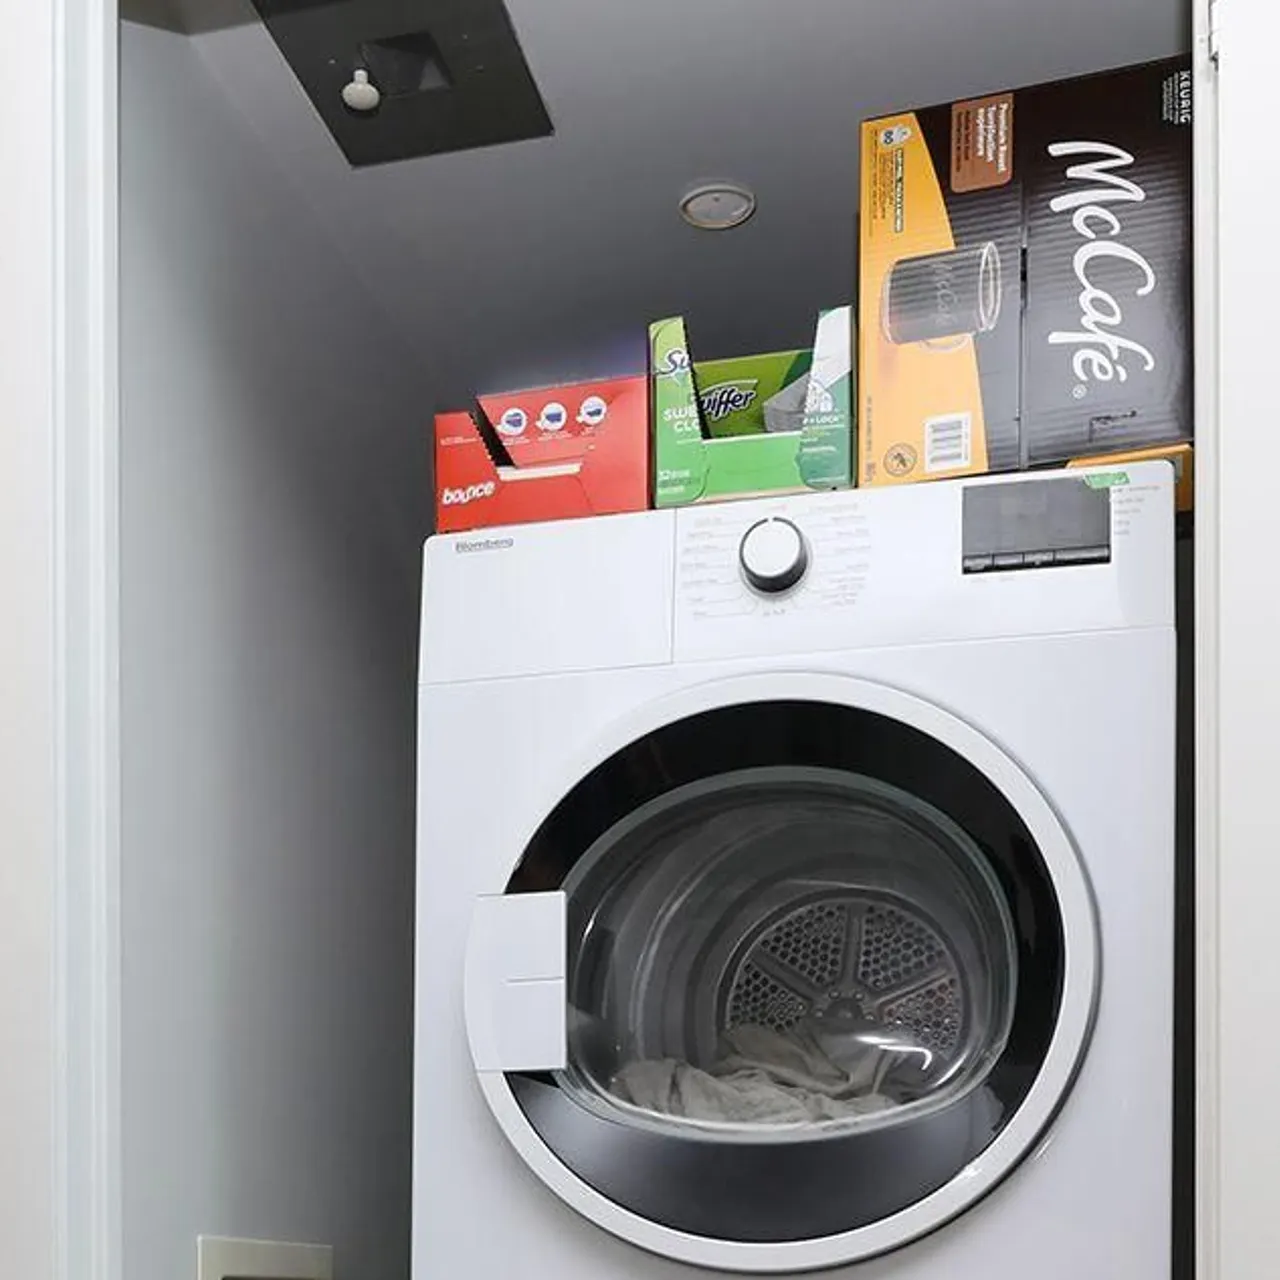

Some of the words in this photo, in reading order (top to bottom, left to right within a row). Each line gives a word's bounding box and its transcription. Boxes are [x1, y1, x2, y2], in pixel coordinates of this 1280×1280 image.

[1179, 70, 1192, 124] KEURIG
[1048, 141, 1156, 382] McCafé
[441, 480, 496, 505] bounce
